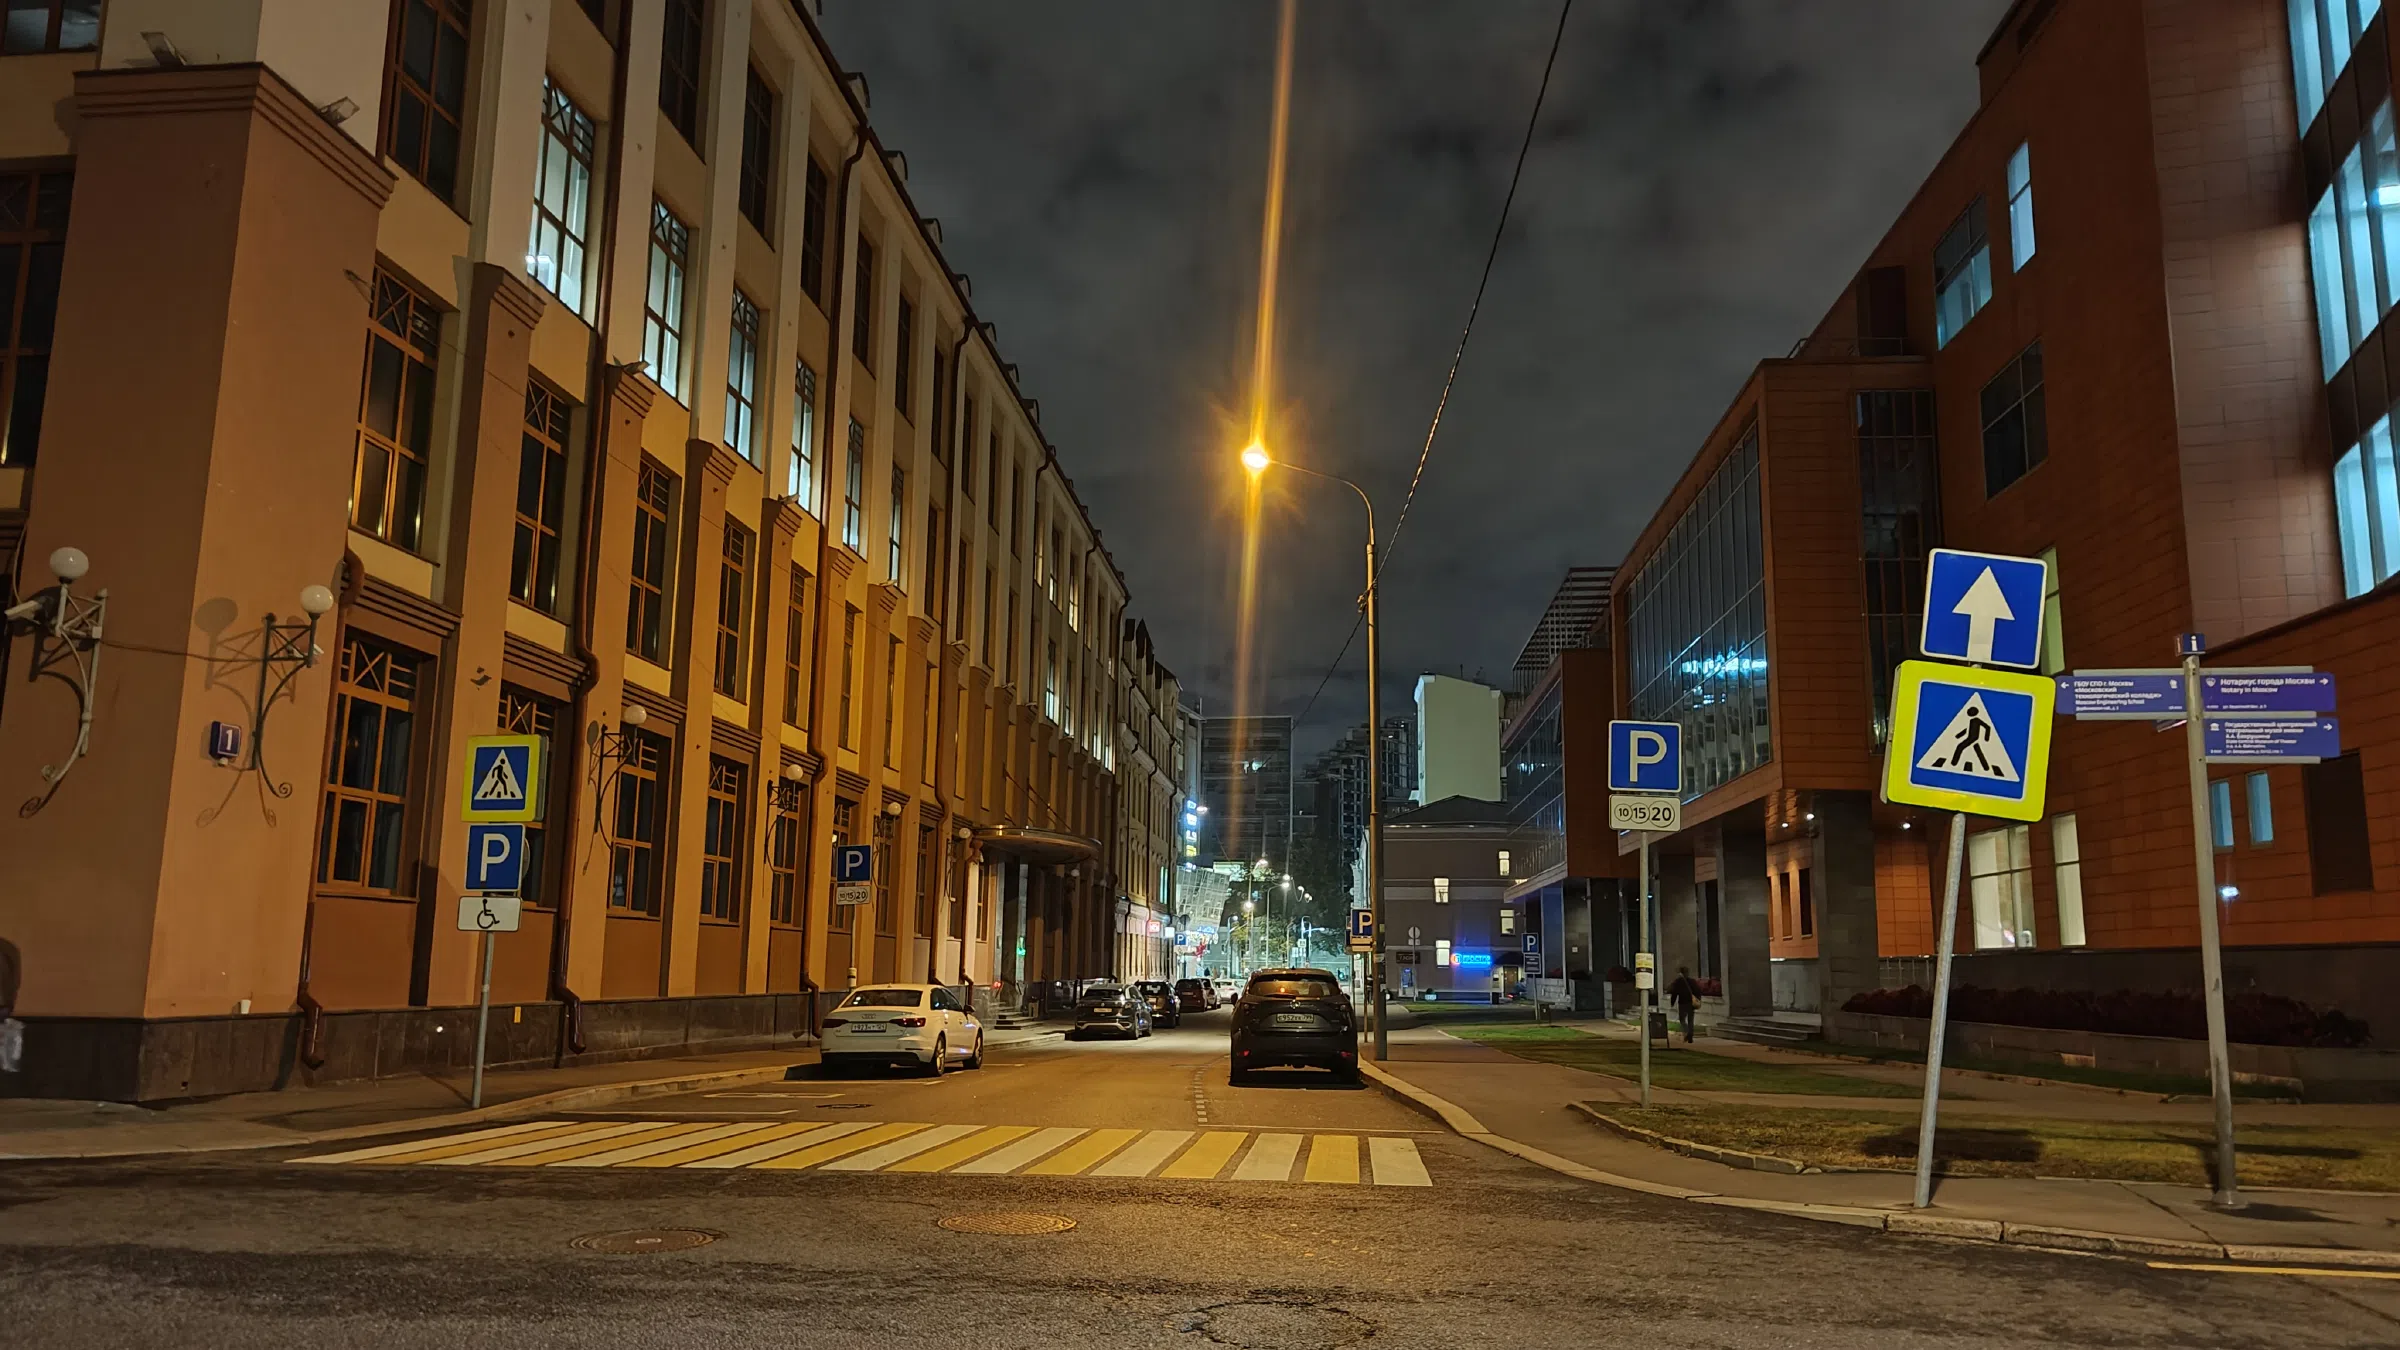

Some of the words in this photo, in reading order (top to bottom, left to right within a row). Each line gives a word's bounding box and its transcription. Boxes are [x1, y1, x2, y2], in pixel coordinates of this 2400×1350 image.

[2220, 678, 2257, 687] Нотариус
[2258, 678, 2284, 686] города
[2285, 677, 2315, 685] Москвы
[2221, 687, 2243, 695] Notary
[226, 730, 233, 750] 1
[1629, 730, 1667, 782] P
[1619, 808, 1629, 817] 10
[1633, 807, 1646, 819] 15
[1651, 807, 1671, 821] 20
[480, 833, 511, 882] P
[845, 850, 863, 878] P
[856, 891, 866, 899] 20
[1359, 911, 1373, 934] P
[1177, 934, 1185, 944] P
[1527, 935, 1537, 951] P
